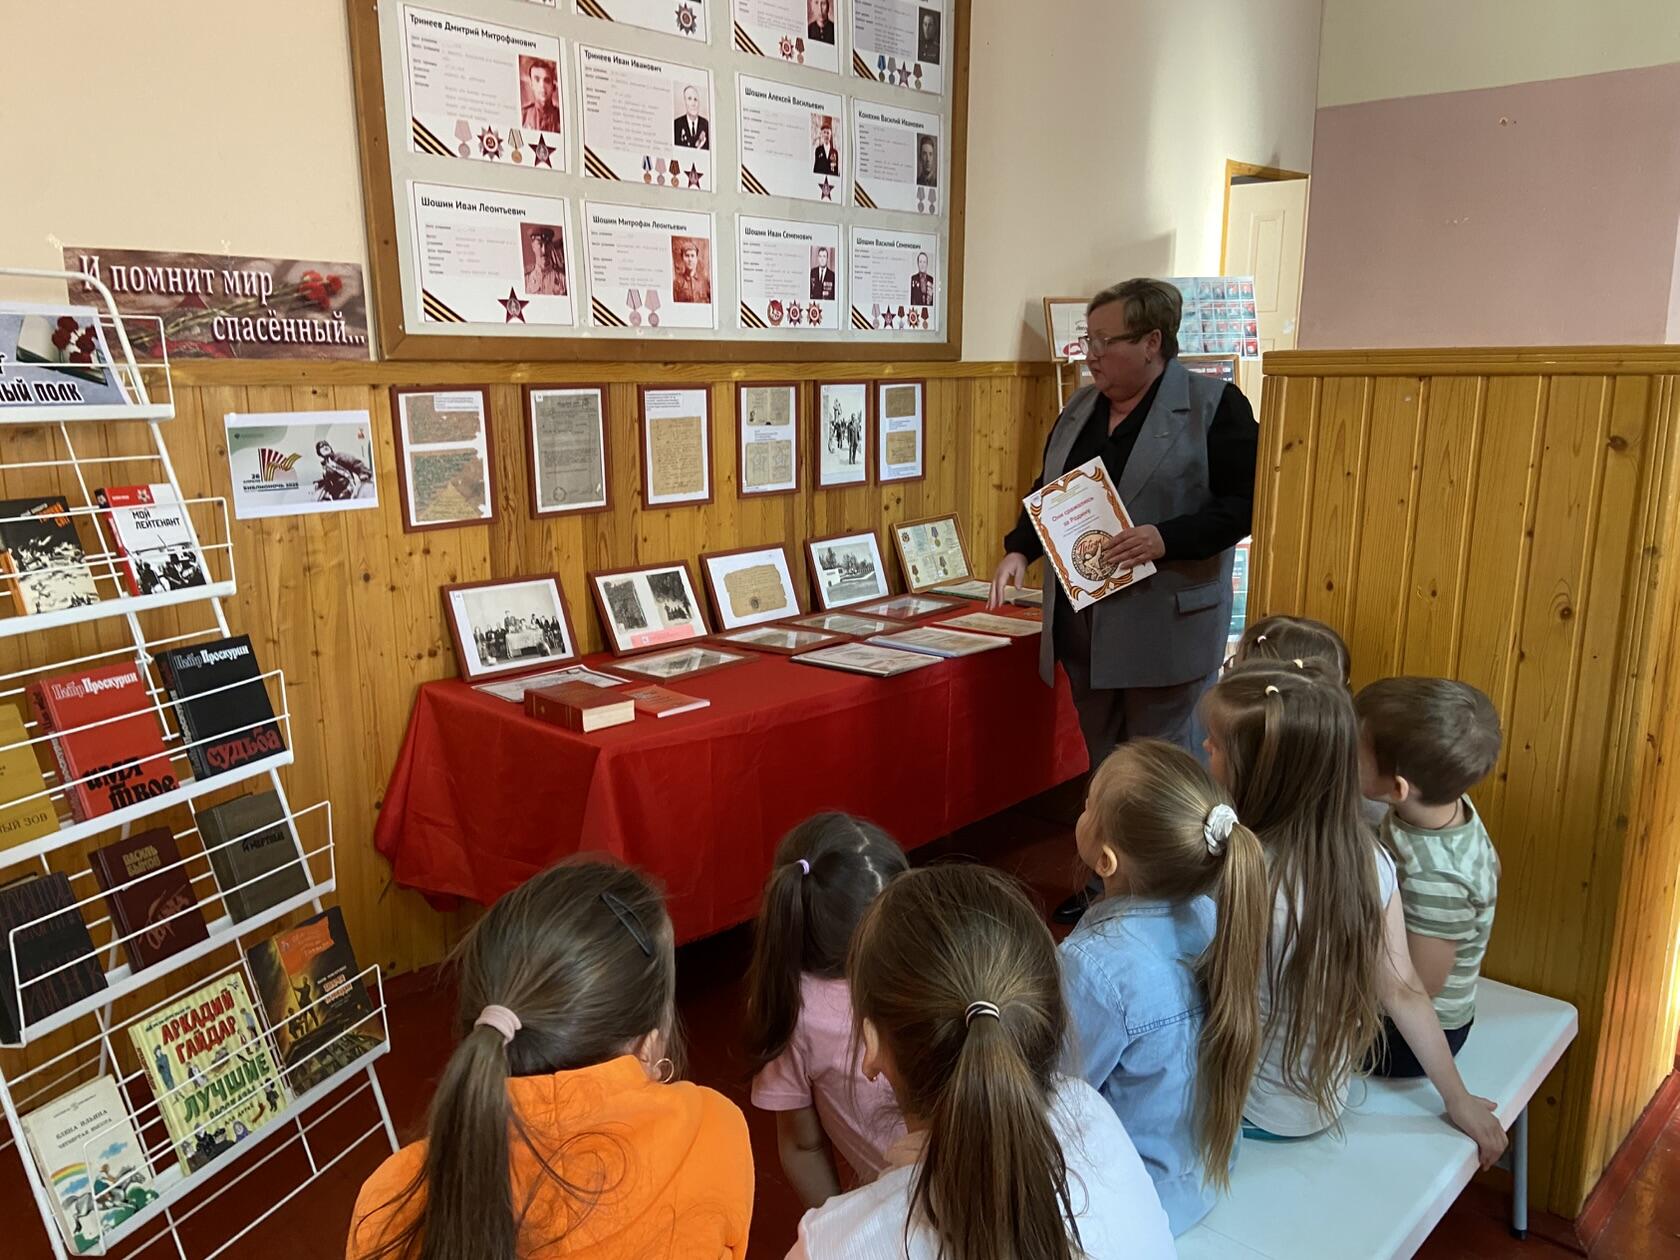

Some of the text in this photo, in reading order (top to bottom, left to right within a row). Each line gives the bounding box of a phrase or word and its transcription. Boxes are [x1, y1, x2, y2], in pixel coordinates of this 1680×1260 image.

[444, 21, 480, 36] Дмитрий
[481, 30, 537, 49] Митрофанович
[613, 55, 630, 66] Иван
[630, 60, 662, 72] Иванович
[744, 87, 825, 111] Шошин Алексей Васильевич
[421, 197, 526, 217] Шошин Иван Леонтьевич
[592, 215, 687, 232] Шошин Митрофан Леонтьевич
[744, 226, 767, 237] Шошин
[767, 229, 782, 239] Иван
[856, 237, 875, 247] Шошин
[78, 254, 273, 306] И помнит мир
[212, 309, 366, 346] спасённый...
[0, 380, 34, 402] ЫЙ
[132, 507, 151, 520] МОЙ
[161, 987, 235, 1046] АРКАДИЙ
[175, 1015, 236, 1065] ГАЙДАР
[184, 1052, 270, 1124] ЛУЧШИЕ
